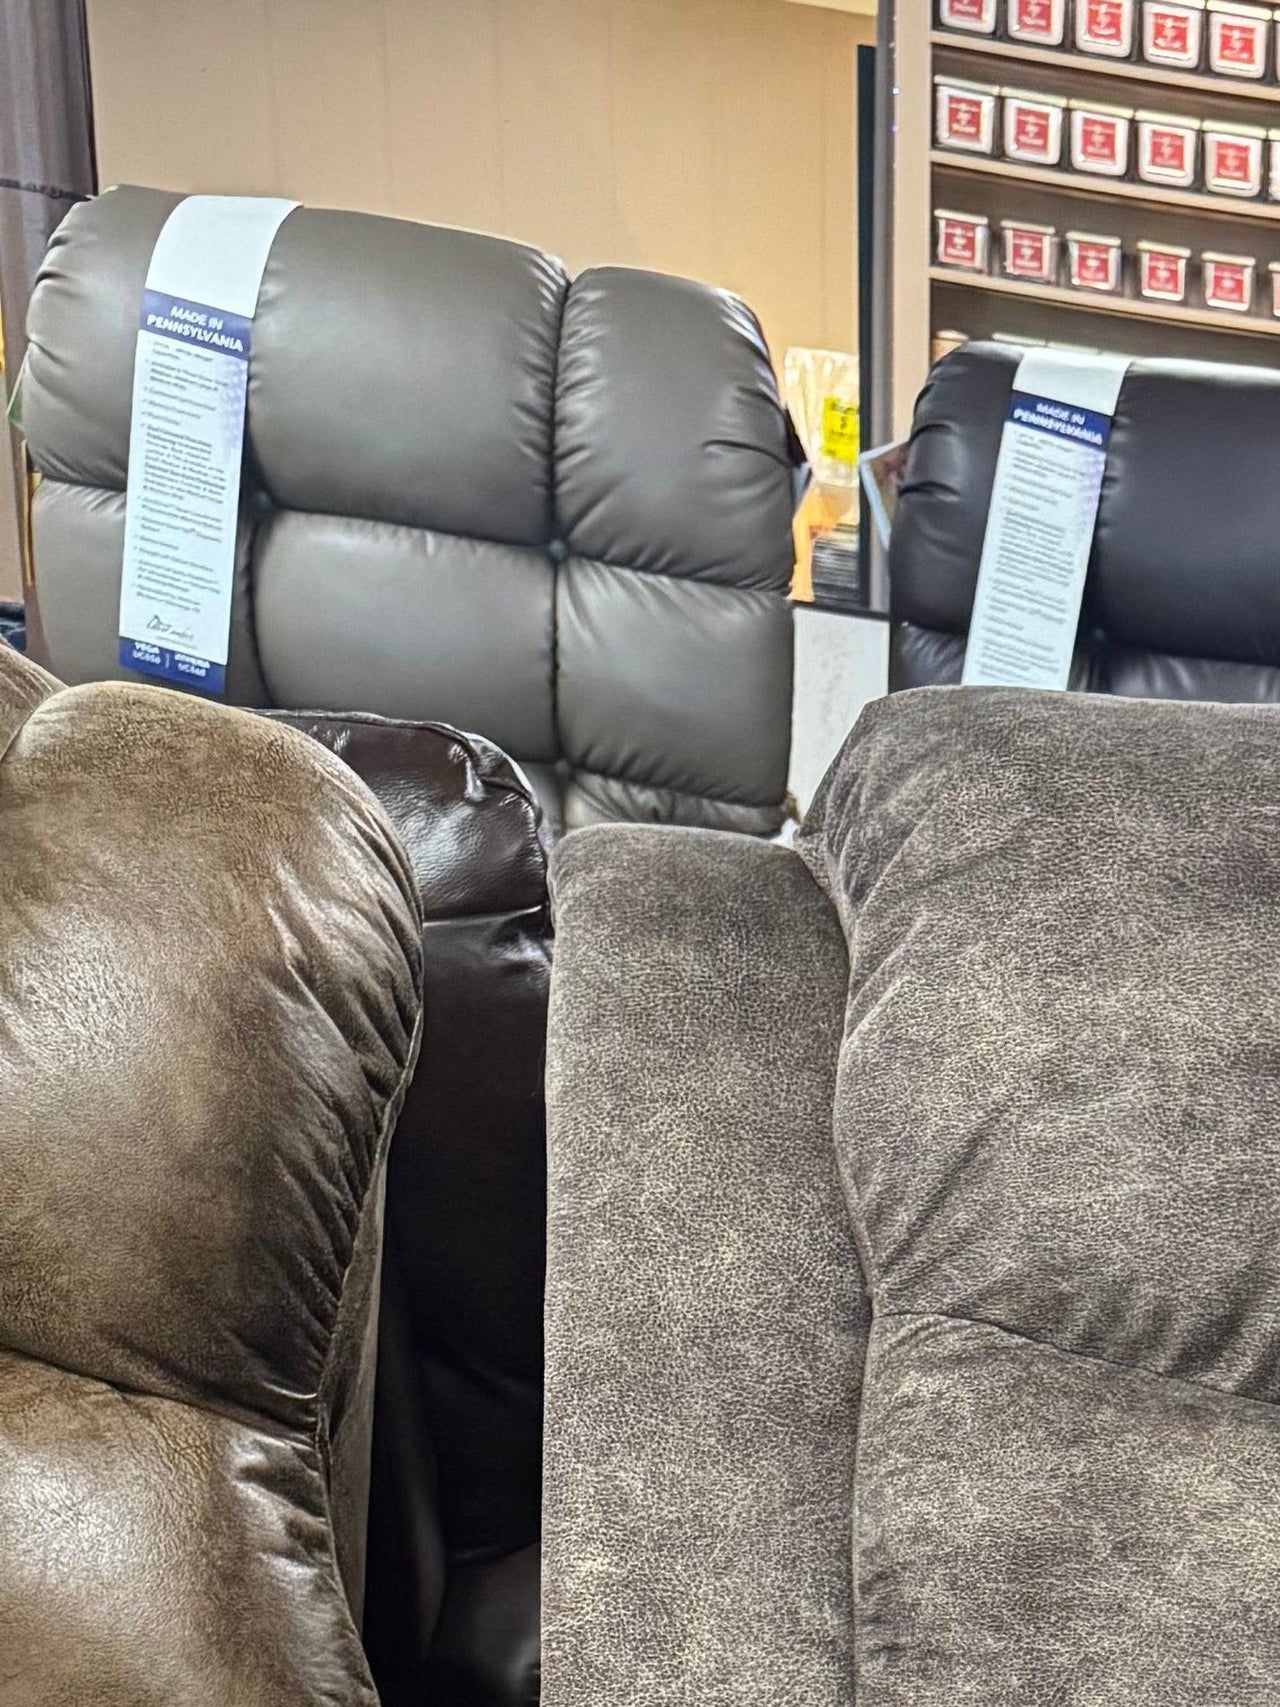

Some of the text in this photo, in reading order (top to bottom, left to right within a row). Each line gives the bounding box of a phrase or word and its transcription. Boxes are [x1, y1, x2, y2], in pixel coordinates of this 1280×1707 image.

[147, 314, 243, 352] PENNSYLVANIA
[171, 306, 224, 330] MADE IN
